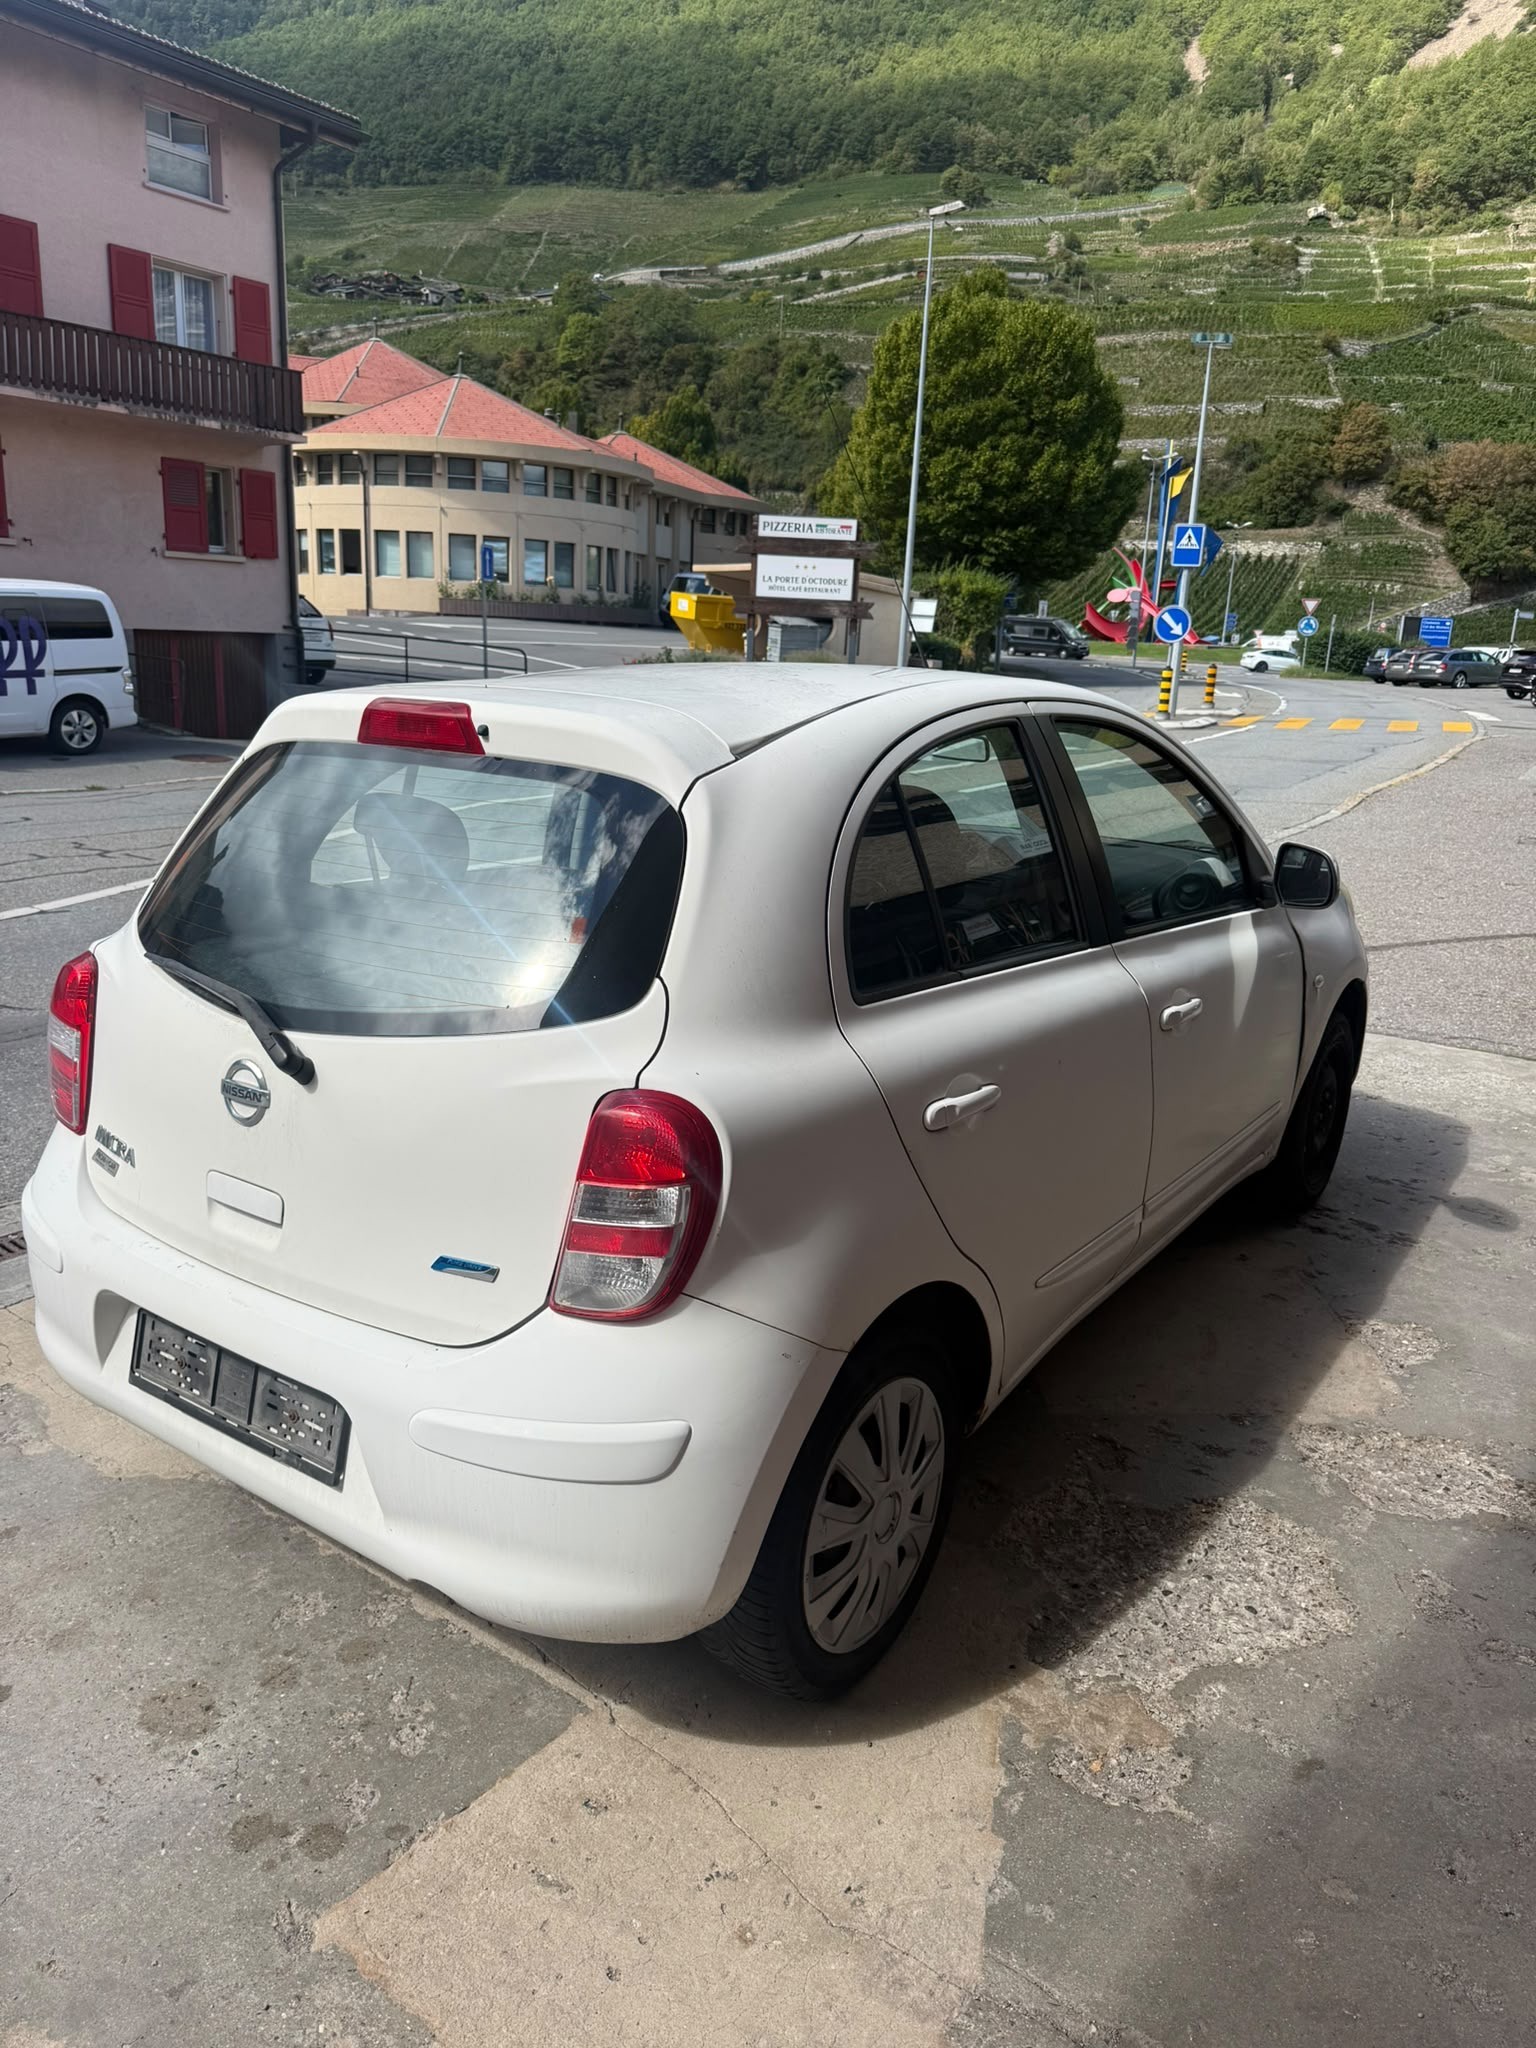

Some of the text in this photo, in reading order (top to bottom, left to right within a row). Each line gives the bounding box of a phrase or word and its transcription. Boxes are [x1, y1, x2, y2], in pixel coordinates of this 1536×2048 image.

[762, 521, 853, 536] PIZZERIA RISTORANTE
[762, 575, 848, 587] LA PORTE D'OCTODURE
[222, 1083, 262, 1103] NISSAN
[94, 1124, 136, 1169] MICRA
